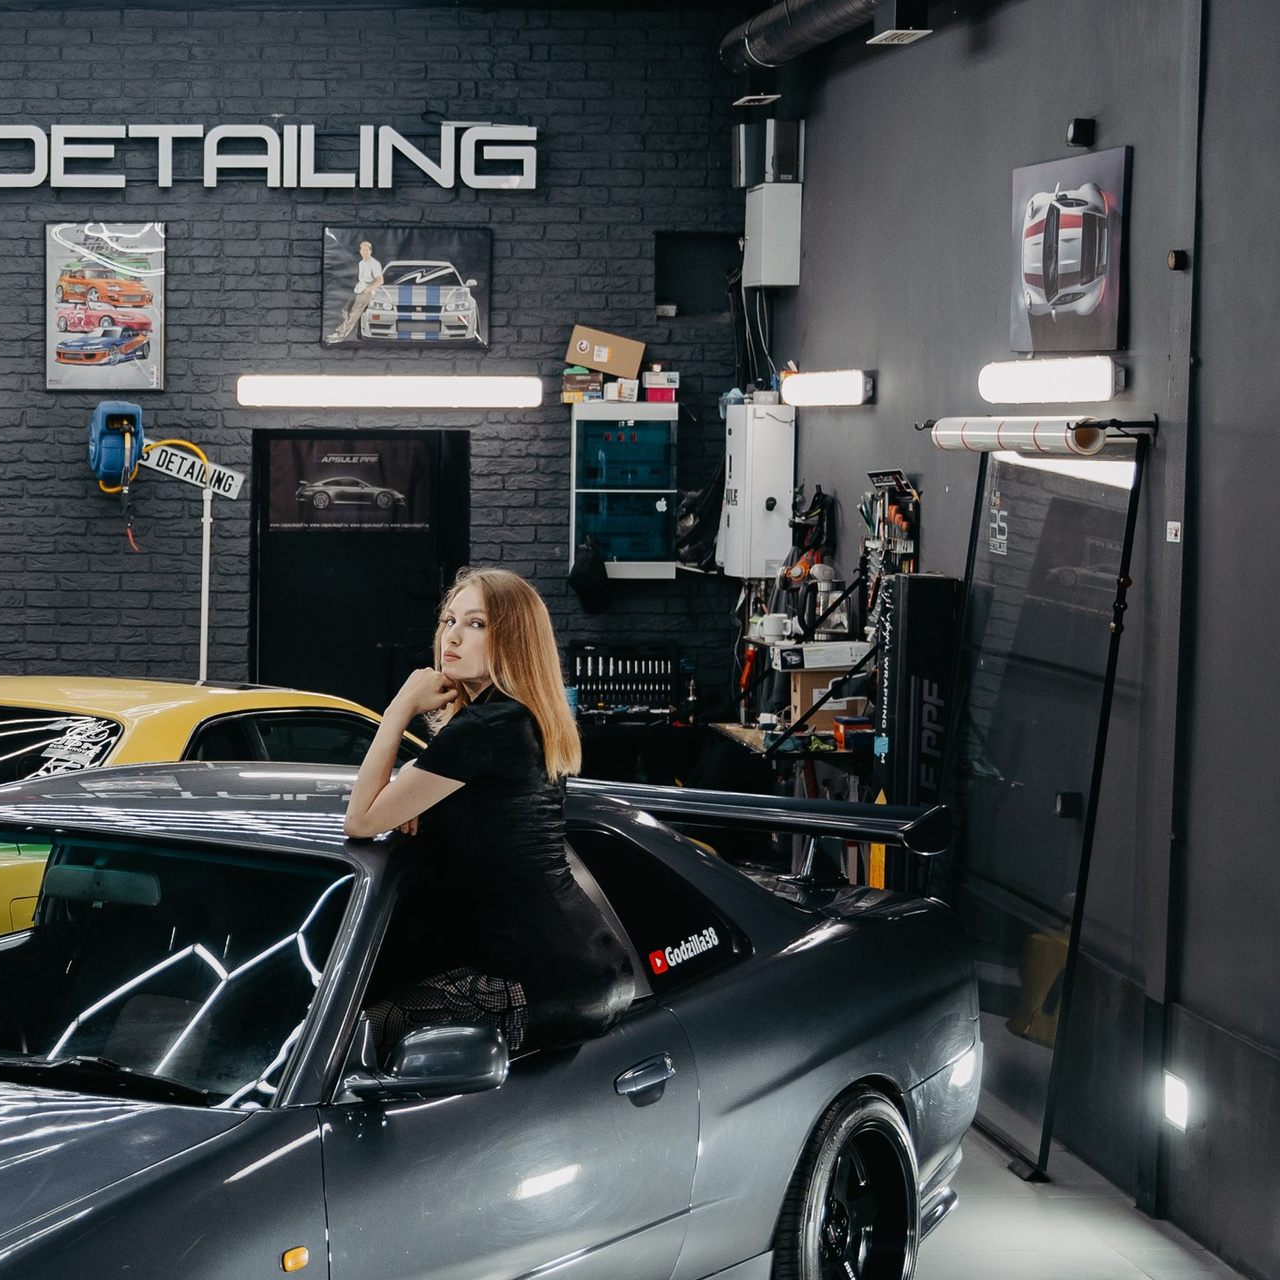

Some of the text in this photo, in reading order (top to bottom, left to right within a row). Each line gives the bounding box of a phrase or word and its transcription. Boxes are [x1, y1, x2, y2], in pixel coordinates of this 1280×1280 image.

[156, 449, 235, 493] DETAILING
[313, 456, 359, 464] APSULE
[881, 657, 889, 729] WRAPPING
[664, 926, 719, 967] Godzilla38
